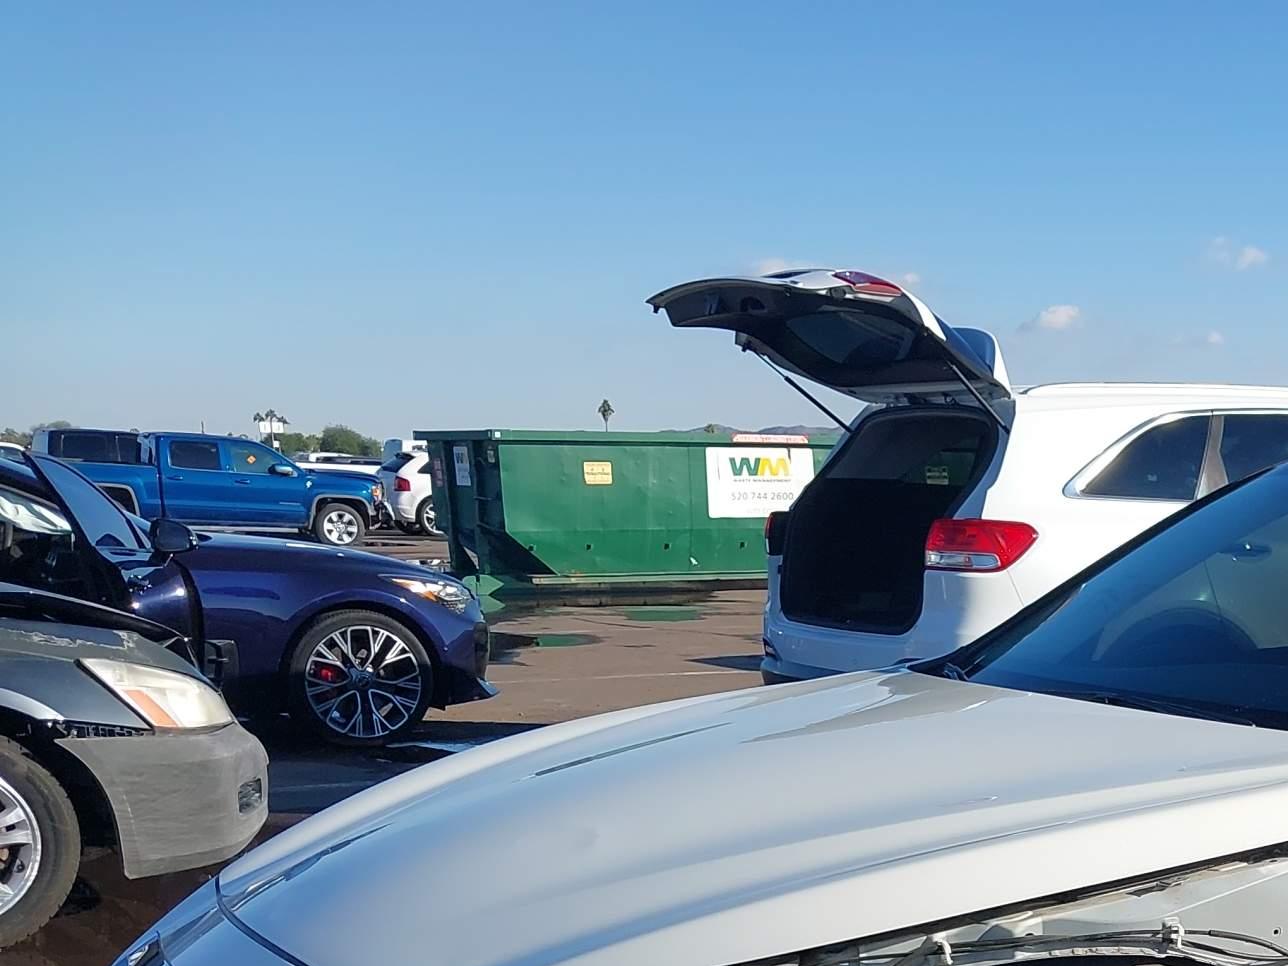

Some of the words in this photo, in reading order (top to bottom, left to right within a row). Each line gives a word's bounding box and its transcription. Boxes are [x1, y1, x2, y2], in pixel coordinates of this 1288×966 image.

[728, 457, 789, 476] WM
[731, 492, 748, 501] 520
[751, 492, 768, 501] 744
[771, 492, 795, 501] 2600
